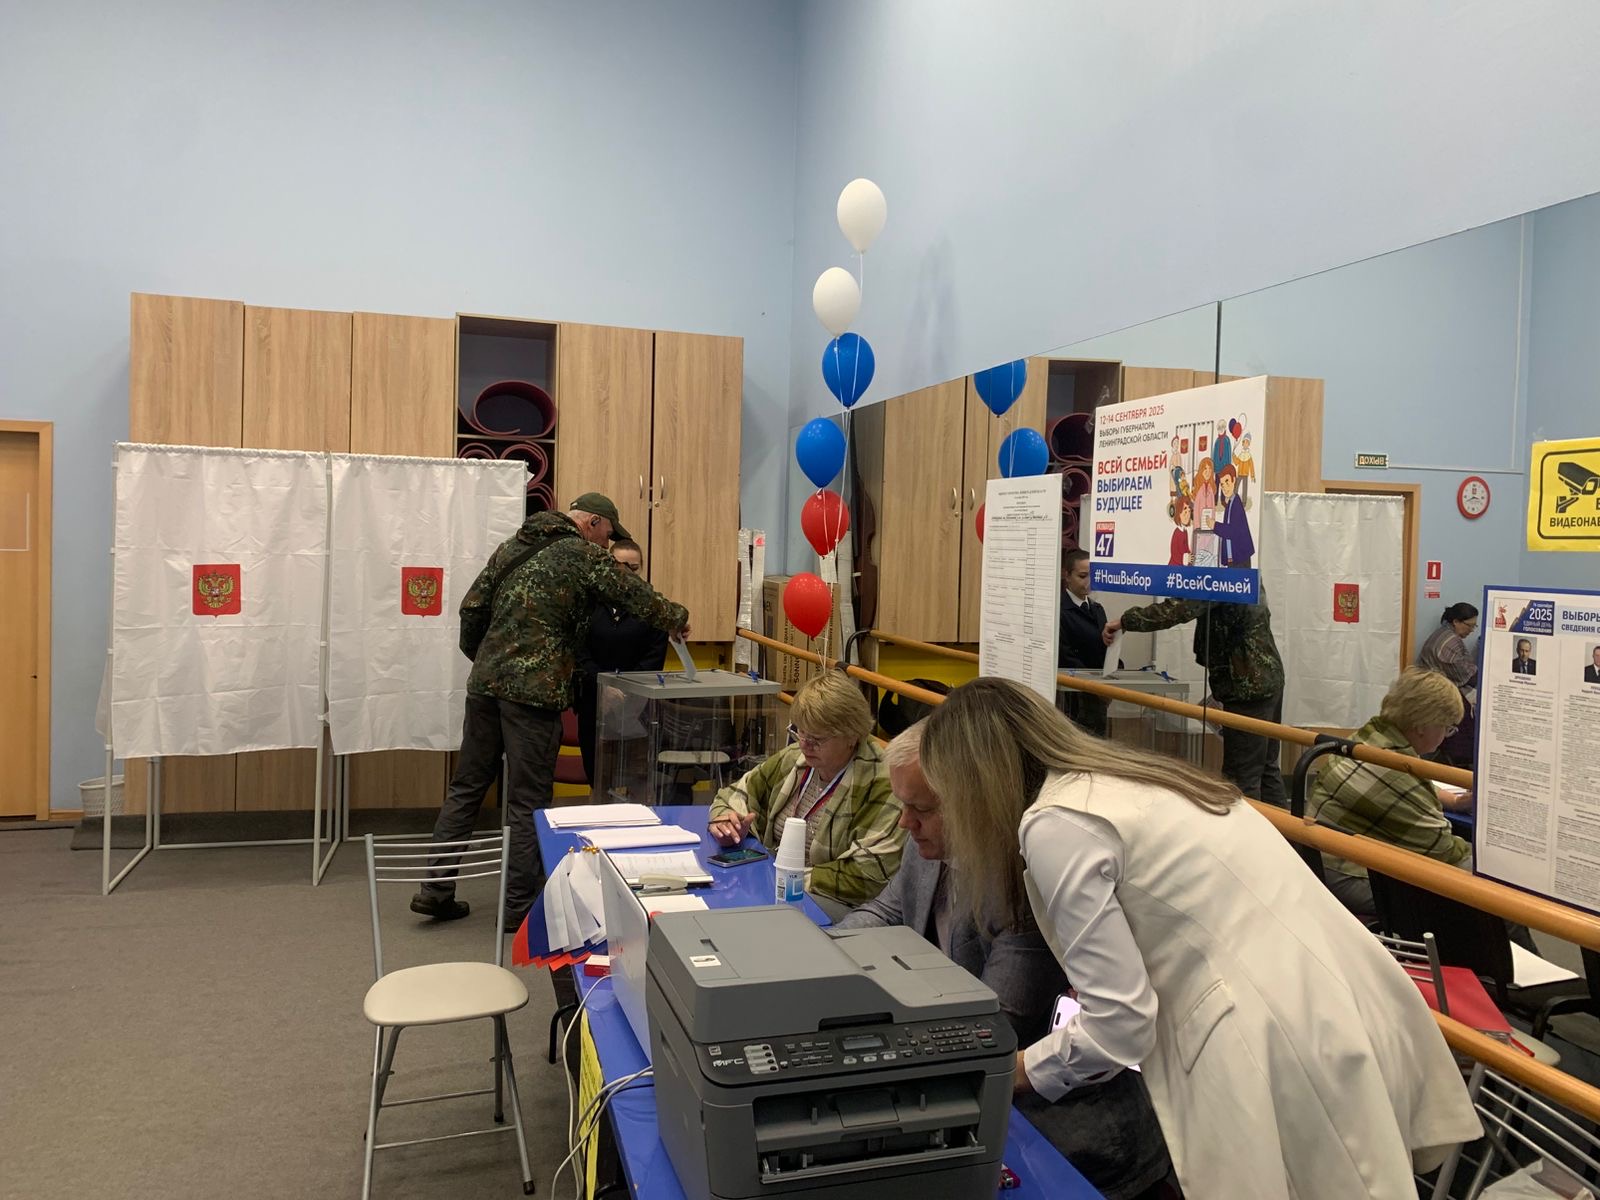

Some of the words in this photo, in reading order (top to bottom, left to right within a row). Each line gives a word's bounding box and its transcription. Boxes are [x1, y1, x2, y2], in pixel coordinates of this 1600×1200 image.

[1114, 409, 1147, 423] СЕНТЯБРЯ
[1148, 404, 1165, 416] 2025
[1099, 427, 1120, 438] ВЫБОРЫ
[1120, 421, 1155, 434] ГУБЕРНАТОРА
[1099, 434, 1141, 448] ЛЕНИНГРАДСКОЙ
[1142, 431, 1169, 442] ОБЛАСТИ
[1098, 456, 1123, 475] ВСЕЙ
[1125, 450, 1168, 472] СЕМЬЕЙ
[1097, 475, 1153, 493] ВЫБИРАЕМ
[1096, 495, 1143, 513] БУДУЩЕЕ
[1096, 533, 1113, 556] 47
[1094, 569, 1152, 591] #НашВыбор
[1166, 572, 1251, 594] #ВсейСемьей
[1529, 608, 1553, 621] 2025
[1561, 624, 1595, 633] СВЕДЕНИЯ
